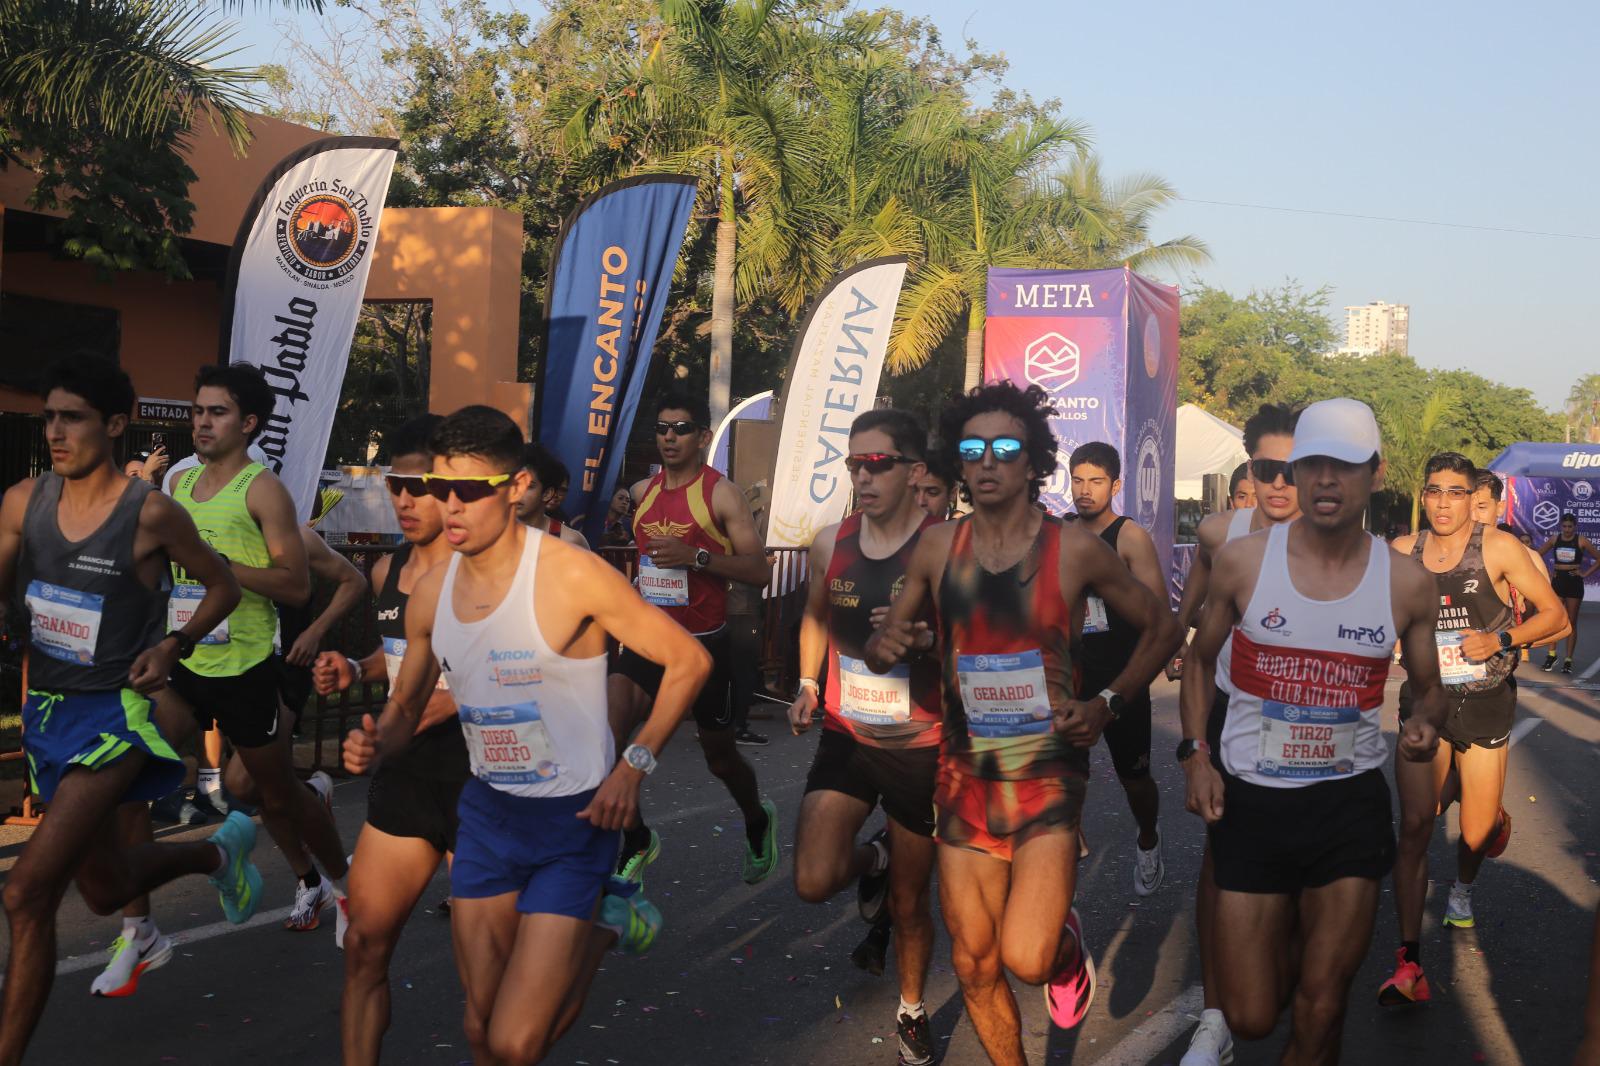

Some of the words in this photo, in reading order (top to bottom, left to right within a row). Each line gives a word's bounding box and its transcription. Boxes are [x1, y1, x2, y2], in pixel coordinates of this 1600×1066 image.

[331, 178, 355, 201] San
[351, 193, 374, 238] Pablo
[277, 233, 296, 266] SERVICIO
[304, 267, 327, 280] SABOR
[337, 252, 362, 276] CALIDAD
[303, 280, 330, 290] SINALOA
[1014, 284, 1094, 308] META
[588, 245, 628, 436] ENCANTO
[260, 296, 318, 406] Pablo
[140, 402, 190, 420] ENTRADA
[1046, 397, 1099, 409] CANTO
[1562, 451, 1600, 469] dpo
[582, 447, 605, 492] EL
[1566, 500, 1594, 508] Carrera
[642, 575, 684, 589] GUILLERMO
[176, 610, 193, 622] EDU
[1439, 606, 1469, 619] ARDIA
[1437, 617, 1471, 630] CIONAL
[1255, 651, 1321, 684] RODOLFO
[847, 684, 870, 702] JOSE
[870, 688, 901, 704] SAUL
[973, 684, 1034, 701] GERARDO
[1270, 680, 1301, 703] CLUB
[480, 729, 519, 745] DIEGO
[1289, 725, 1333, 741] TIRZO
[484, 746, 531, 762] ADOLFO
[1282, 741, 1336, 759] EFRAÍN
